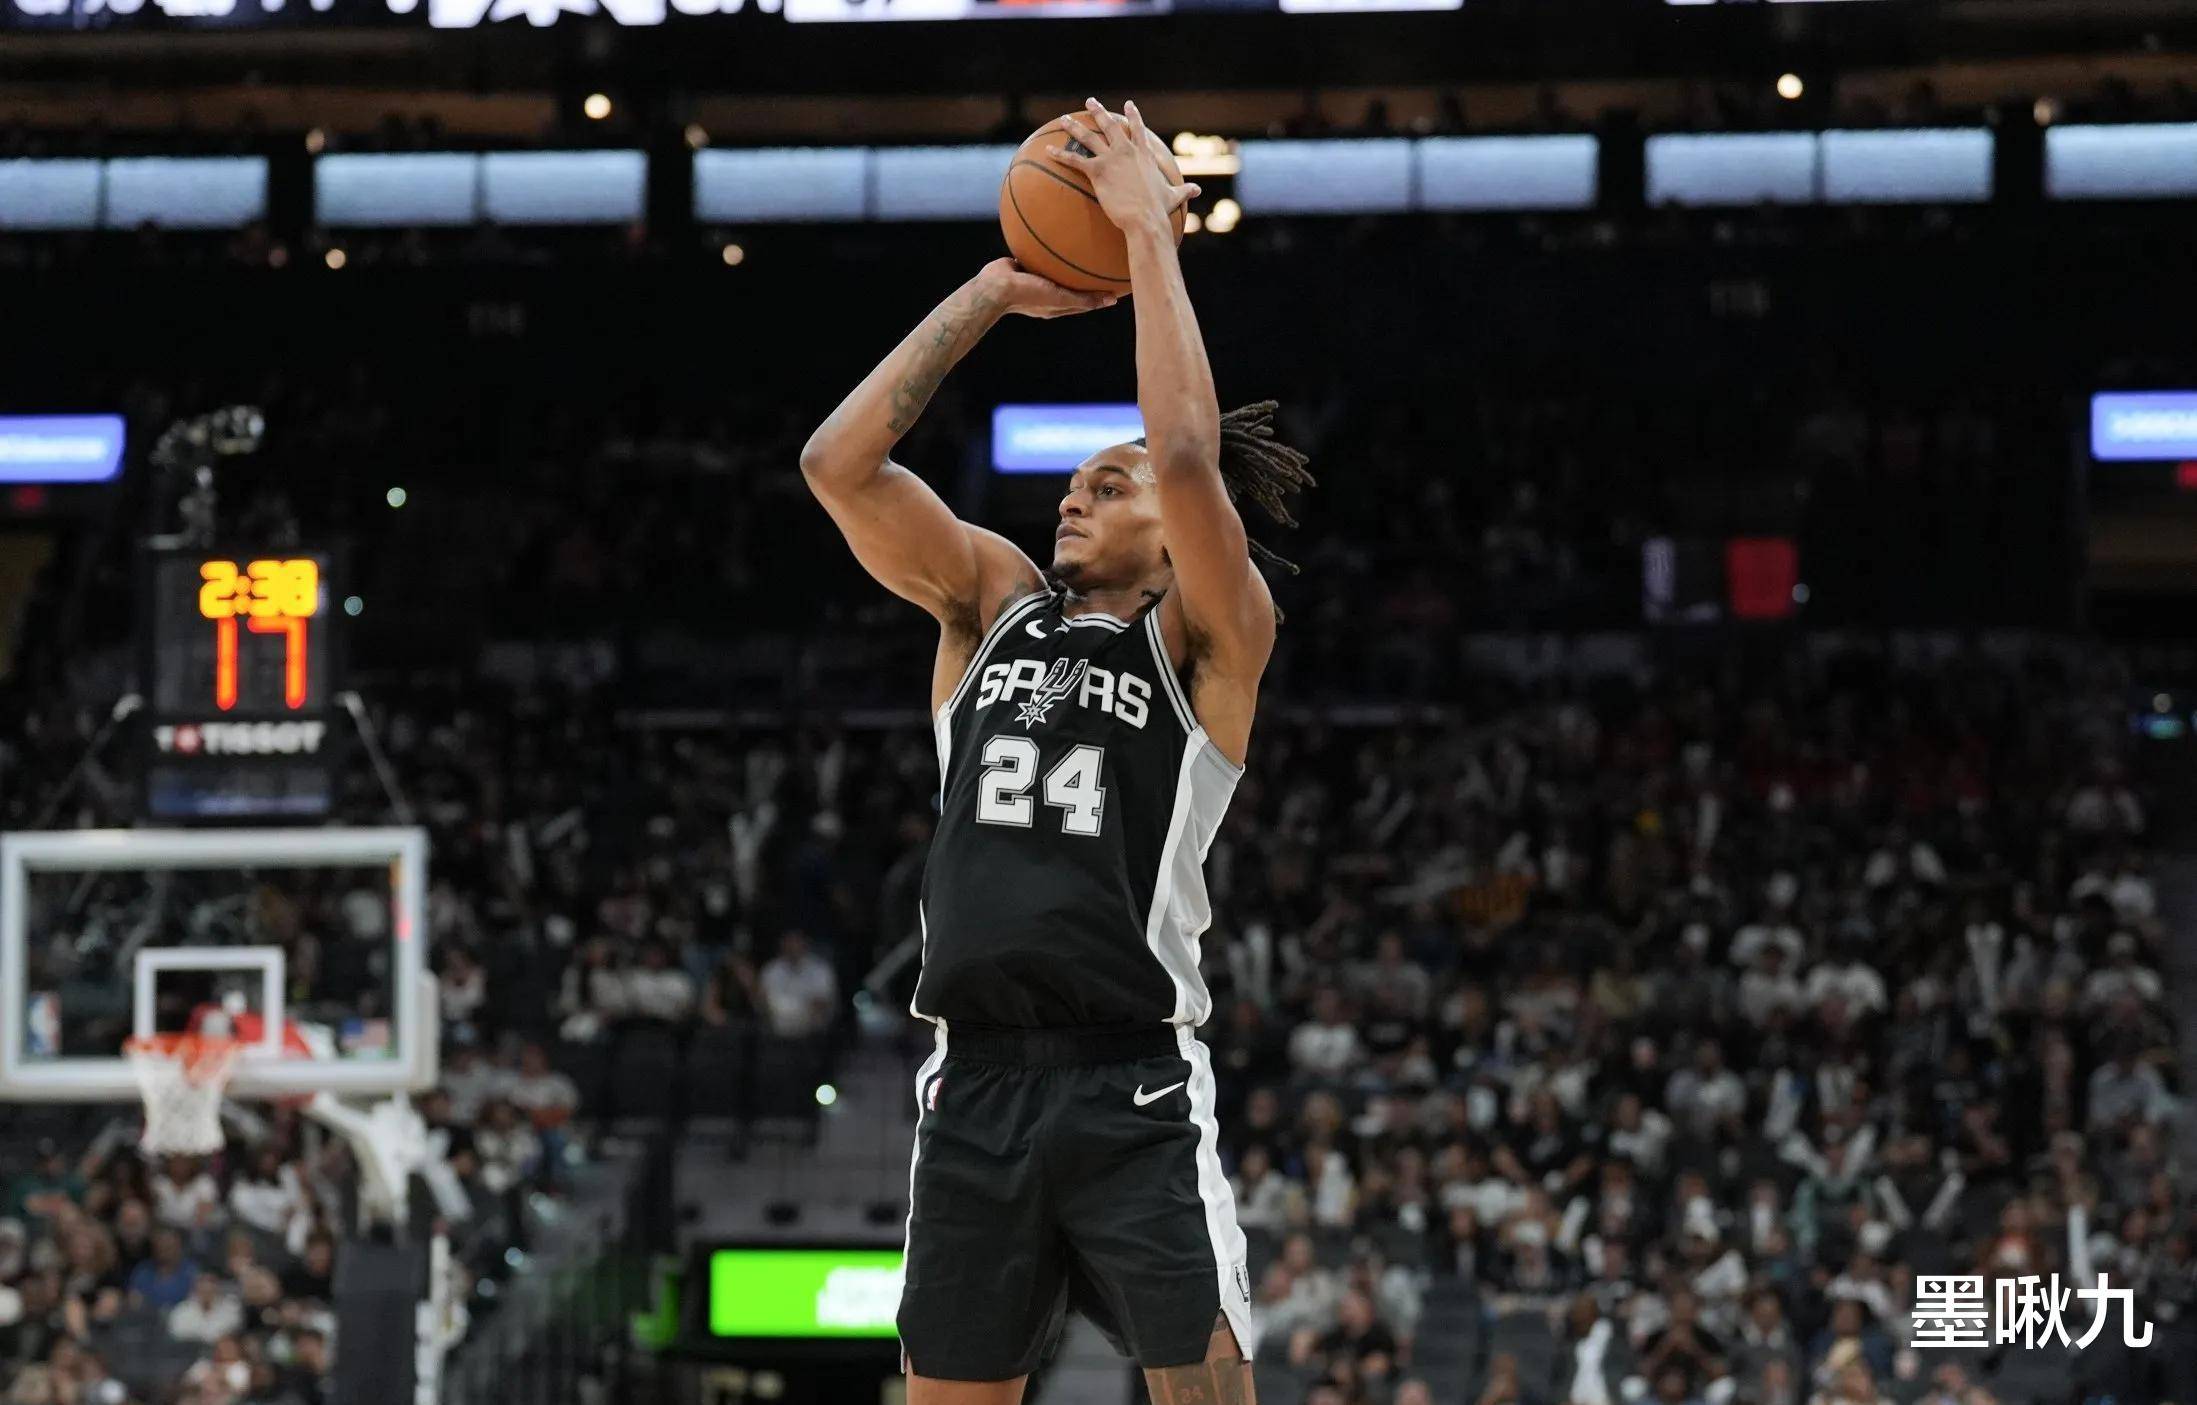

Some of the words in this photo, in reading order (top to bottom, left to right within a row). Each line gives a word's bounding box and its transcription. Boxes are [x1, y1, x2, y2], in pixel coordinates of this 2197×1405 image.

[217, 616, 307, 710] 17
[976, 657, 1152, 730] SPURS
[976, 734, 1106, 837] 24
